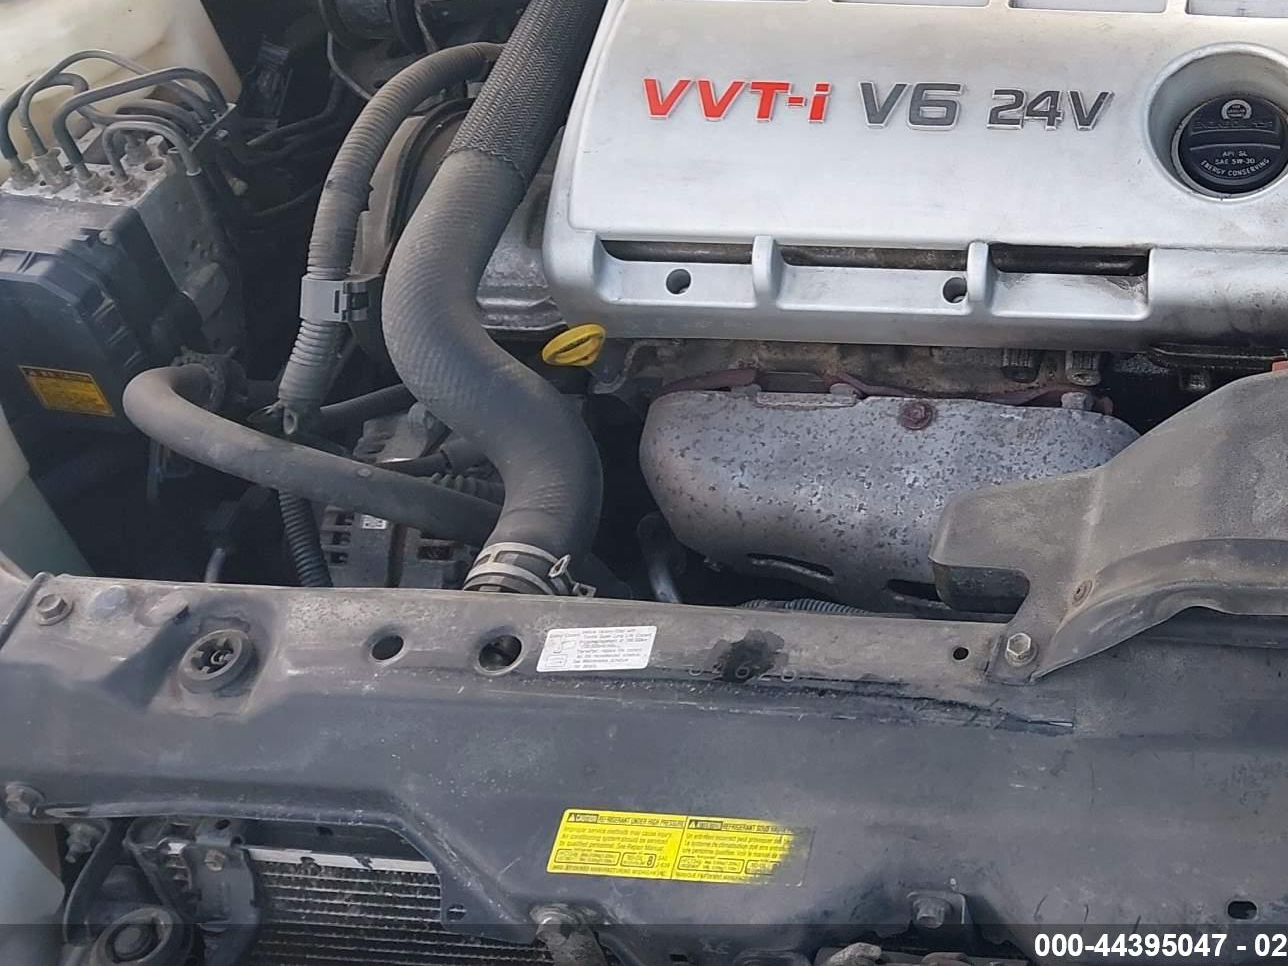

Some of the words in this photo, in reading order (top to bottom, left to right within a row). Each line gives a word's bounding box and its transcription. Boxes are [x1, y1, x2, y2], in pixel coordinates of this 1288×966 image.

[643, 77, 832, 122] VVT-i
[858, 80, 964, 131] V6
[985, 87, 1115, 132] 24V
[1201, 160, 1225, 175] ENERGY
[1228, 158, 1270, 176] CONSERVING
[1231, 157, 1256, 165] 5W-30
